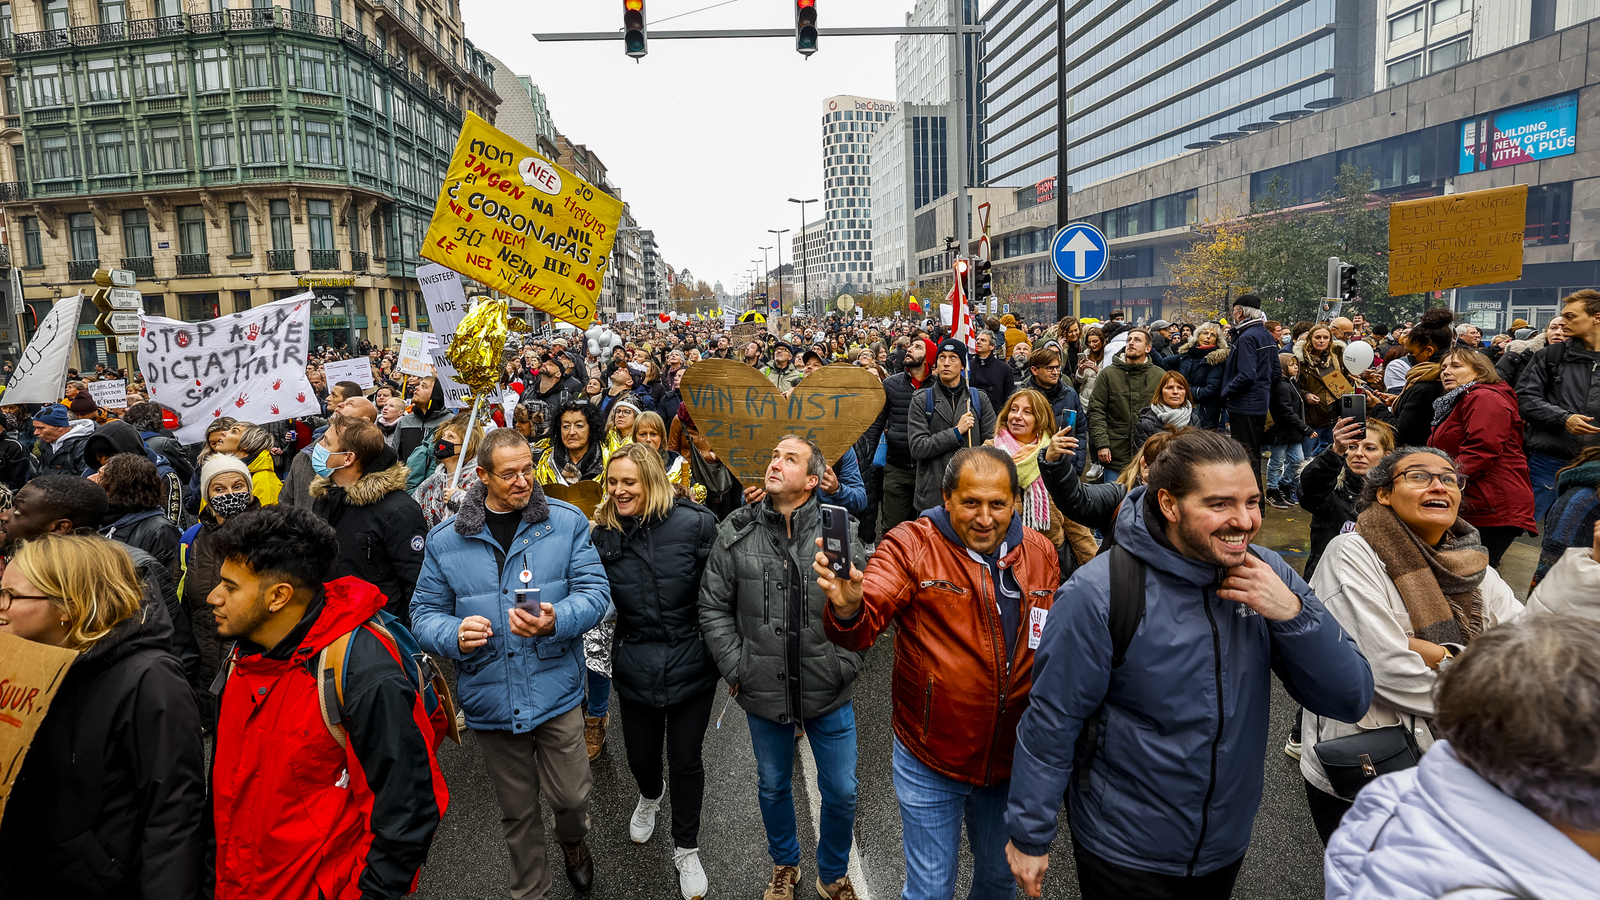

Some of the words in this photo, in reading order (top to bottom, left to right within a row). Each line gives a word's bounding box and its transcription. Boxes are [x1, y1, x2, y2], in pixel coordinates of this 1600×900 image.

[1494, 121, 1547, 140] BUILDING
[1495, 138, 1520, 150] NEW
[1524, 127, 1567, 144] OFFICE
[1525, 146, 1535, 156] A
[1539, 135, 1576, 153] PLUS
[465, 173, 477, 186] EI
[527, 162, 556, 190] NEE
[1035, 177, 1056, 195] THON
[575, 183, 593, 202] JO
[1037, 193, 1053, 204] HOTELS
[447, 199, 473, 223] NEJ
[531, 198, 554, 217] NA
[1402, 204, 1436, 221] EEN
[468, 192, 592, 265] CORONAPAS
[564, 196, 606, 241] HAYIR
[1455, 209, 1498, 233] GEEN
[436, 235, 457, 255] LE
[492, 228, 526, 250] NEM
[567, 226, 593, 247] NIL
[466, 252, 493, 271] NEI
[497, 246, 538, 280] NEIN
[1395, 252, 1428, 268] EEN
[1437, 250, 1494, 265] QR-CODE
[1436, 267, 1461, 278] WEL
[1466, 258, 1512, 276] MENSEN
[298, 278, 355, 287] RESTAURANT
[420, 271, 456, 286] INVESTEER
[550, 286, 589, 320] NÃO
[146, 323, 216, 354] STOP
[688, 383, 734, 414] VAN
[705, 420, 763, 441] ZET
